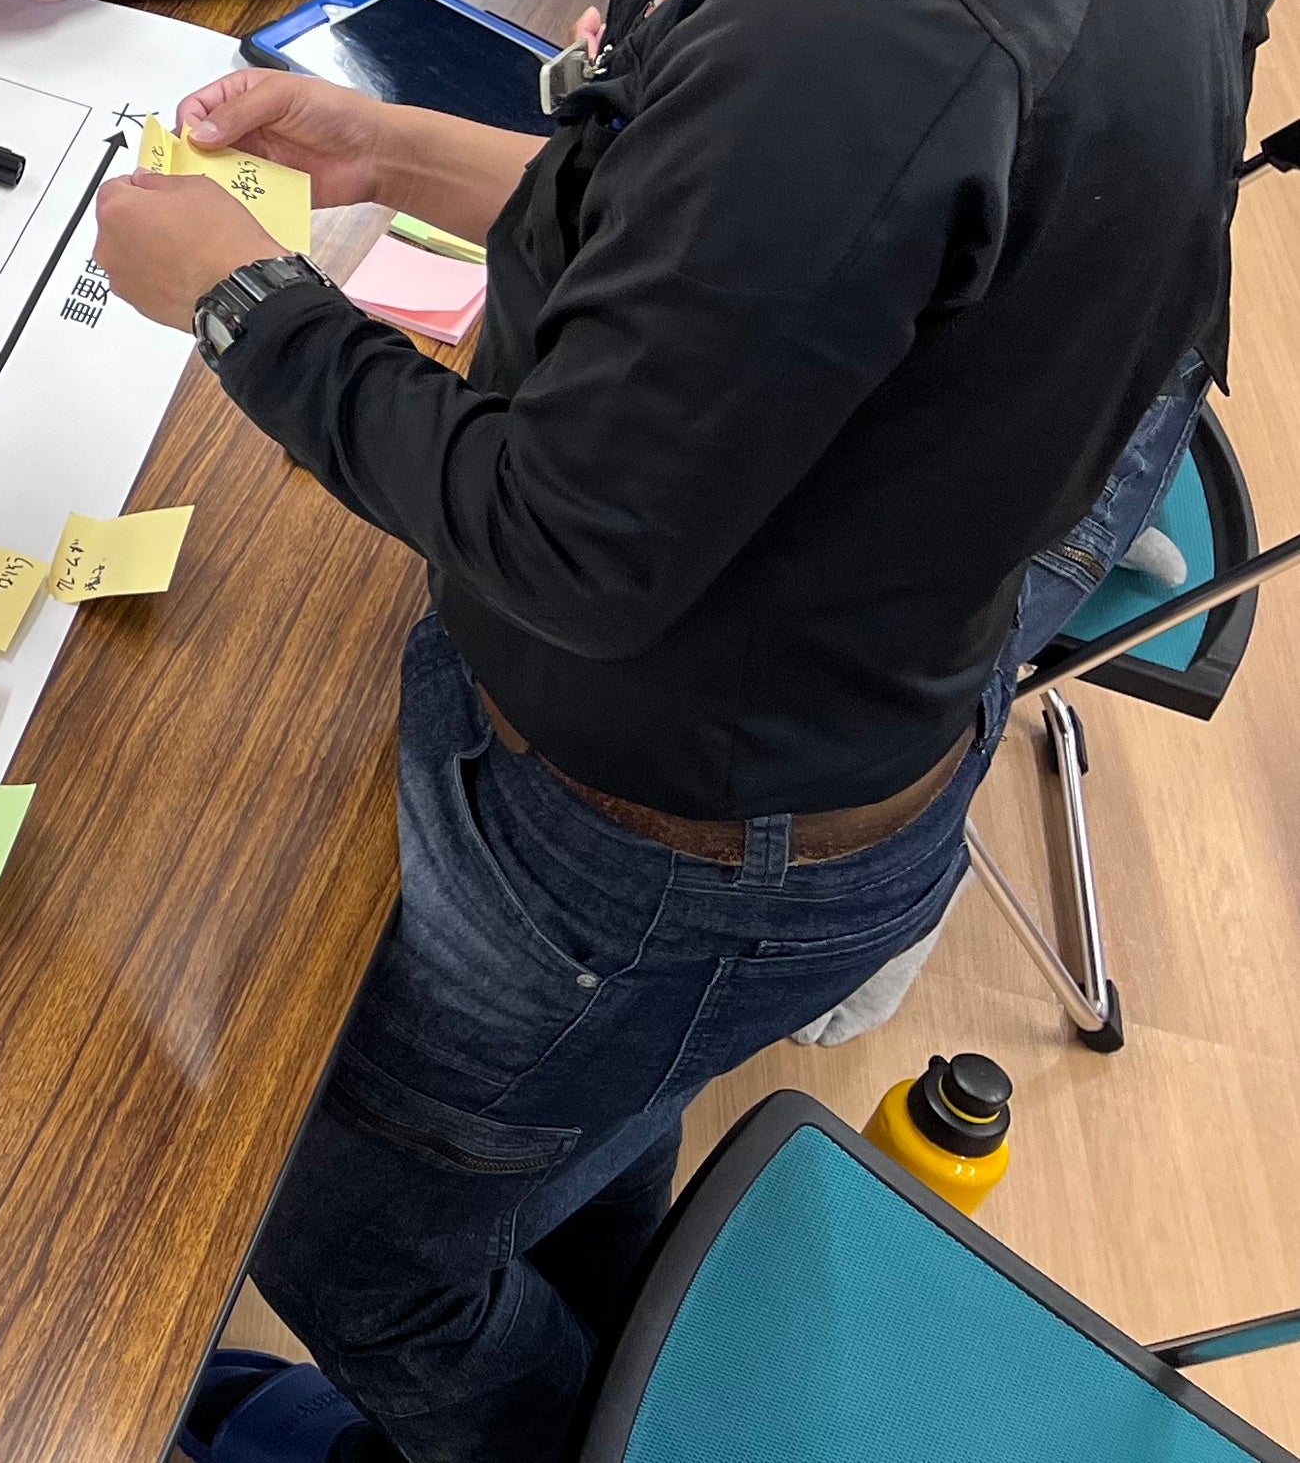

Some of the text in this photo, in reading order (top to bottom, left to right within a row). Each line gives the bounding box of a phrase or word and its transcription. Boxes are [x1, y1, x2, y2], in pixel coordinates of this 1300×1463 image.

[55, 538, 85, 592] クレームが
